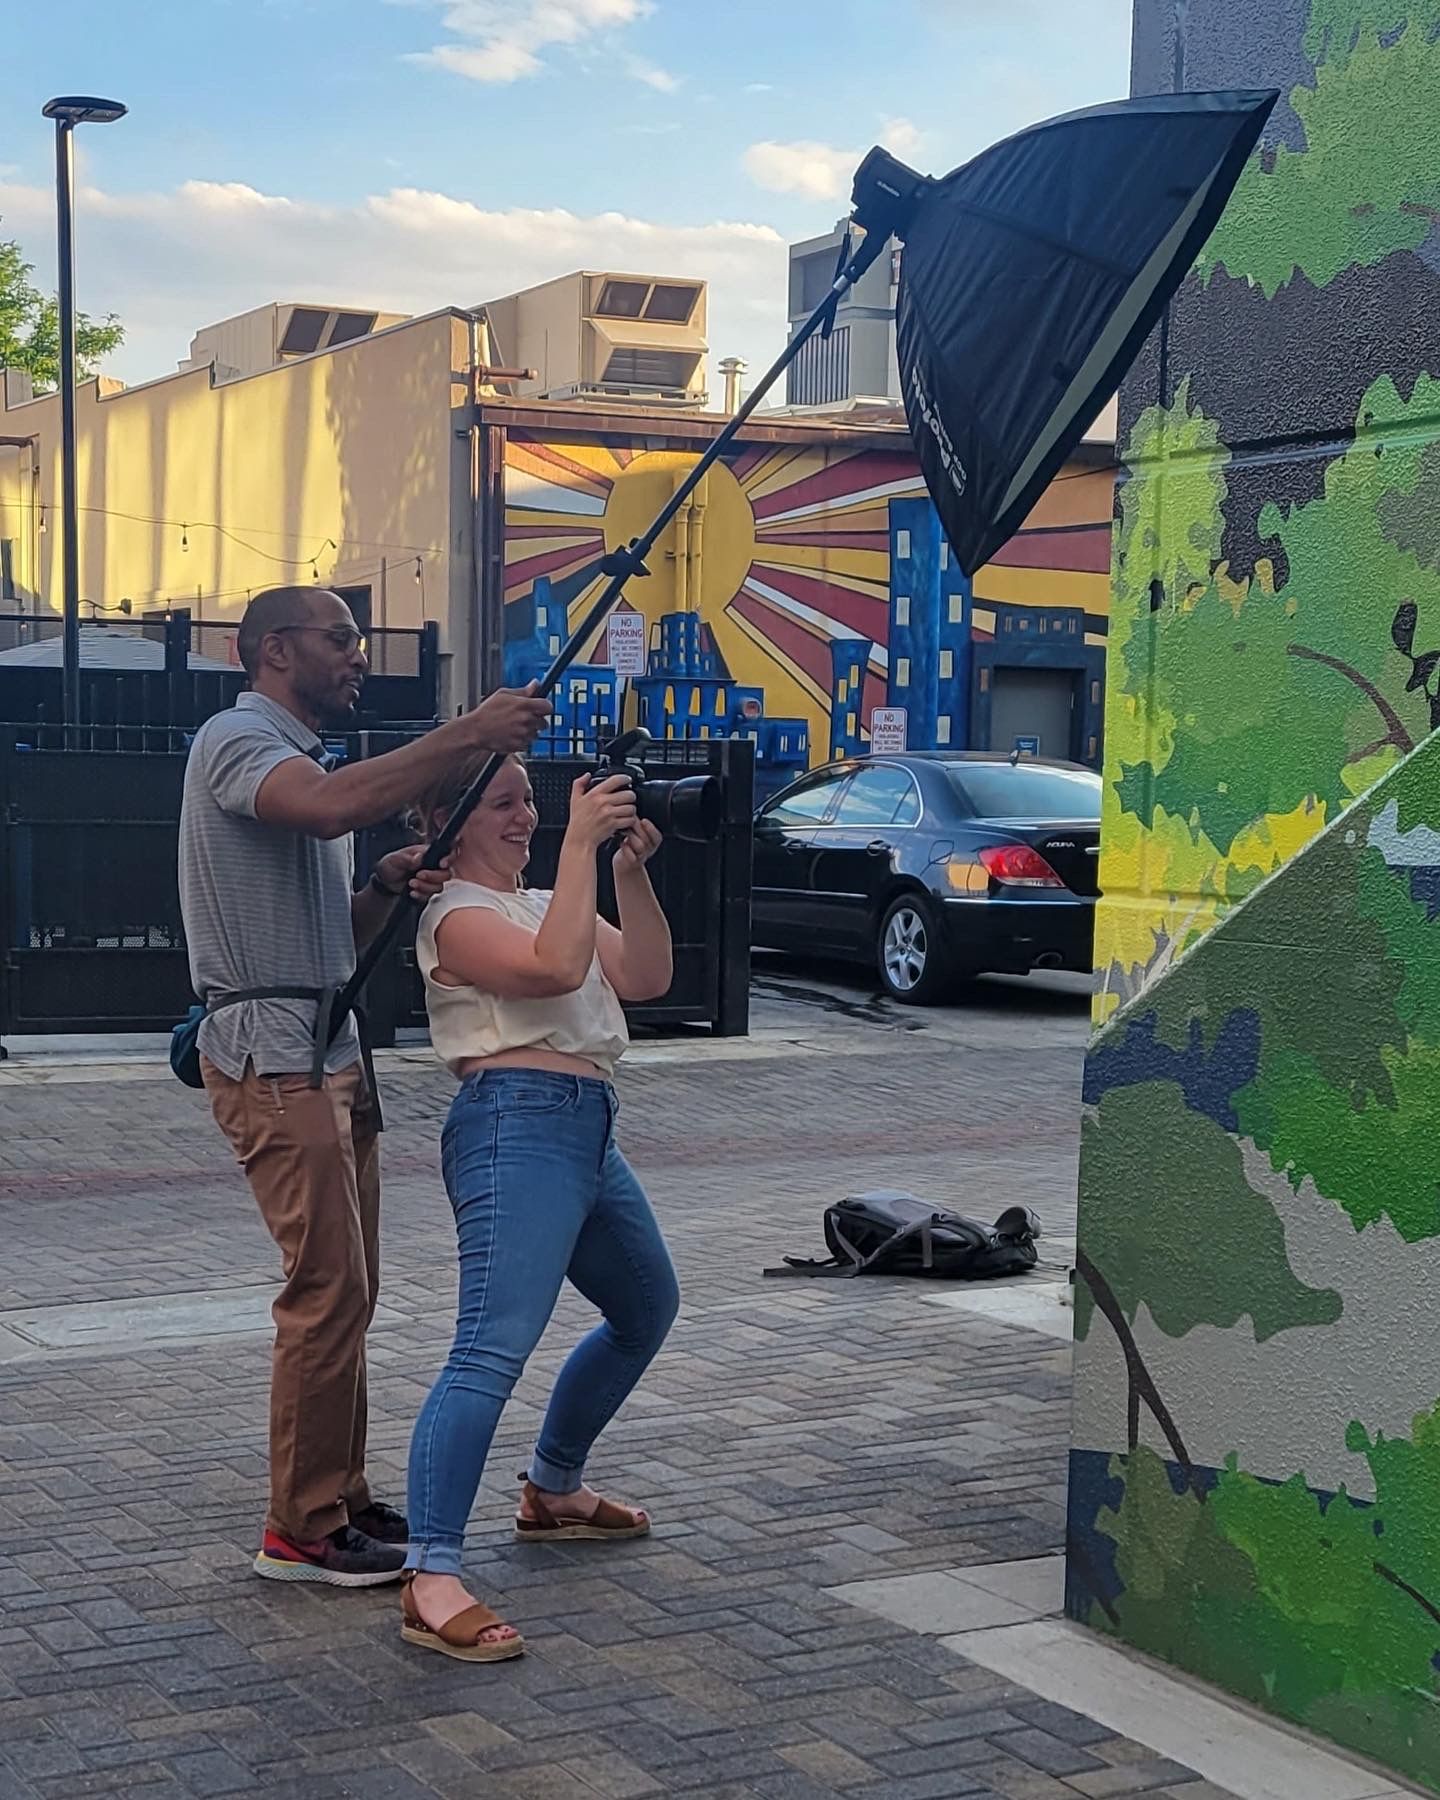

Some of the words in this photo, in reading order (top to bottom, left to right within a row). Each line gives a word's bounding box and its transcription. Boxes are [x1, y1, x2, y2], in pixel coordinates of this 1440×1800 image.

[912, 365, 951, 470] Profoto
[621, 618, 632, 627] NO
[610, 629, 643, 638] PARKING
[884, 713, 894, 722] NO
[874, 724, 904, 733] PARKING
